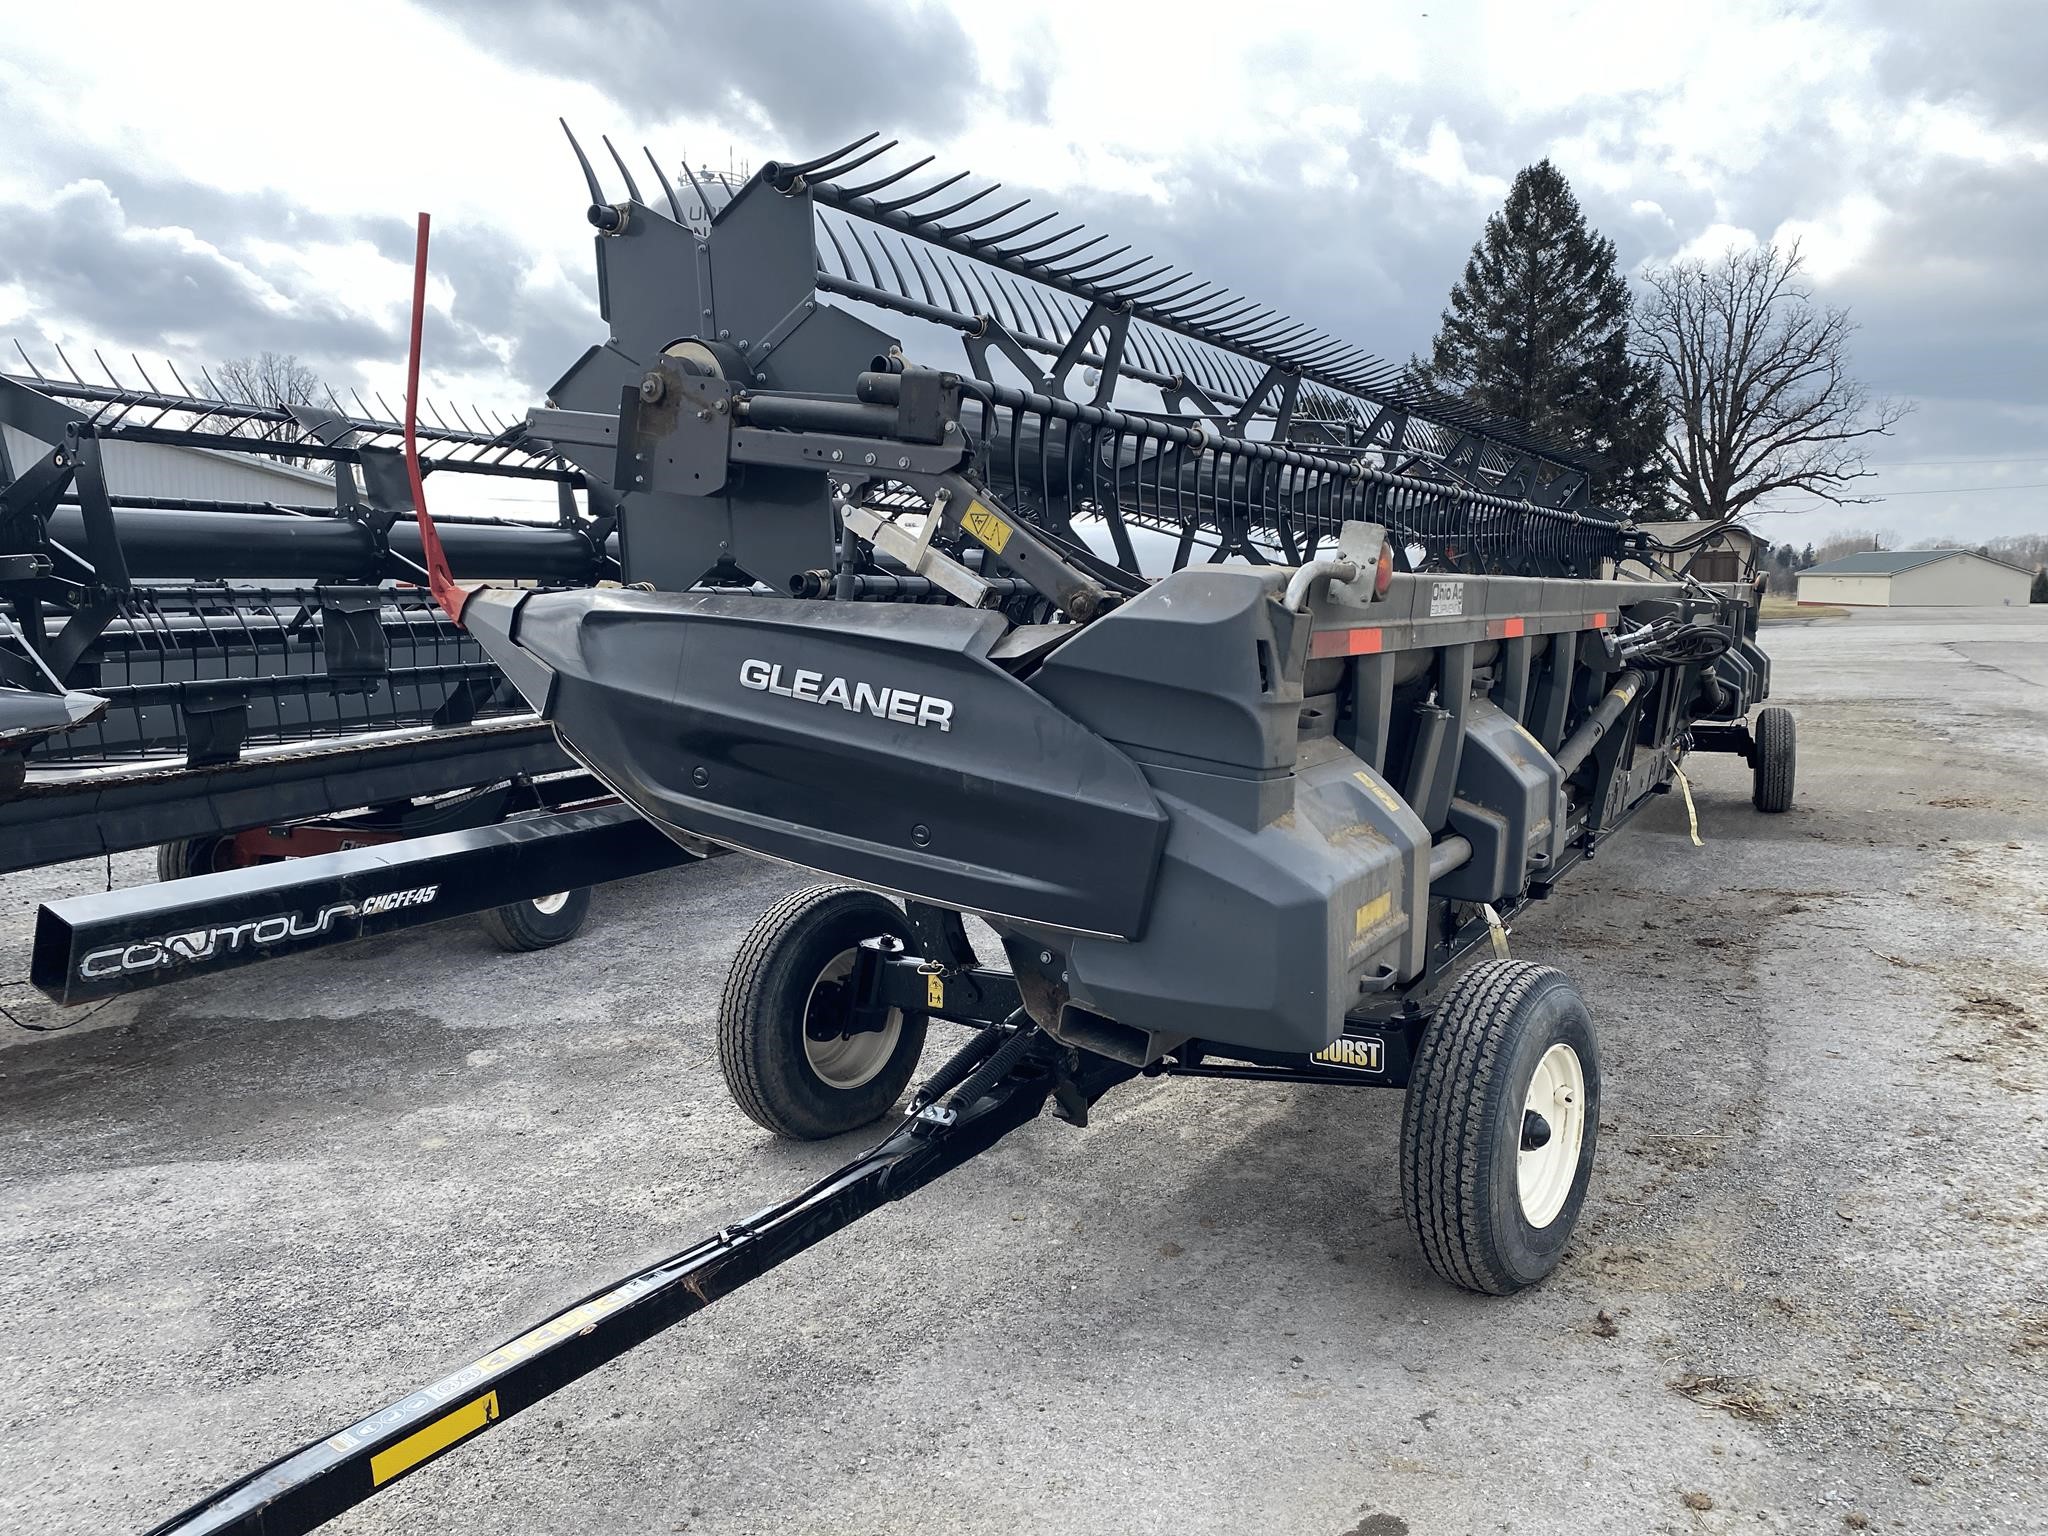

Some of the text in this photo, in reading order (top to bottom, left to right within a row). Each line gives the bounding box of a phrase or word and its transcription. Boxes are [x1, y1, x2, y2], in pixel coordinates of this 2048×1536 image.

[1432, 583, 1463, 605] Ohio Ag
[739, 658, 954, 732] GLEANER
